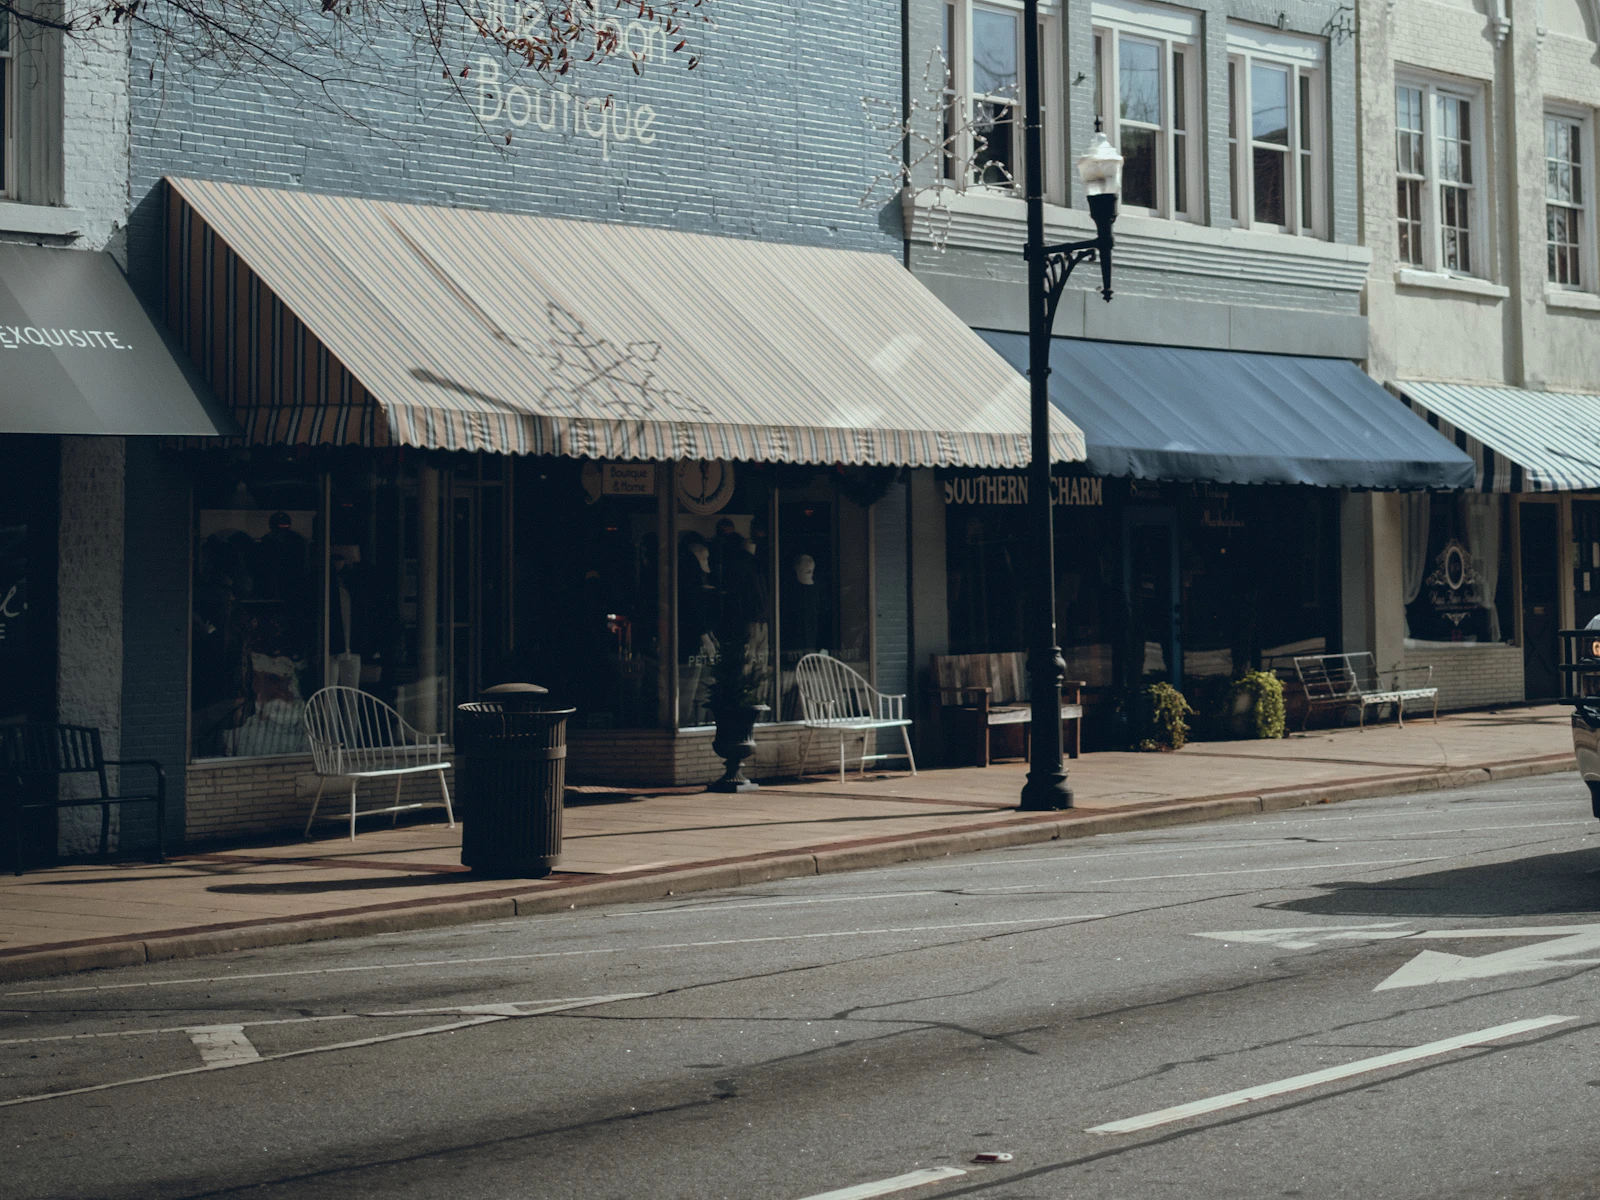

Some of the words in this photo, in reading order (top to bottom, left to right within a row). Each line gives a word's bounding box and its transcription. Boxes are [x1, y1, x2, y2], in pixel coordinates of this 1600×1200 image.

[477, 57, 657, 162] Boutique
[944, 475, 1029, 505] SOUTHERN
[1049, 476, 1103, 506] CHARM
